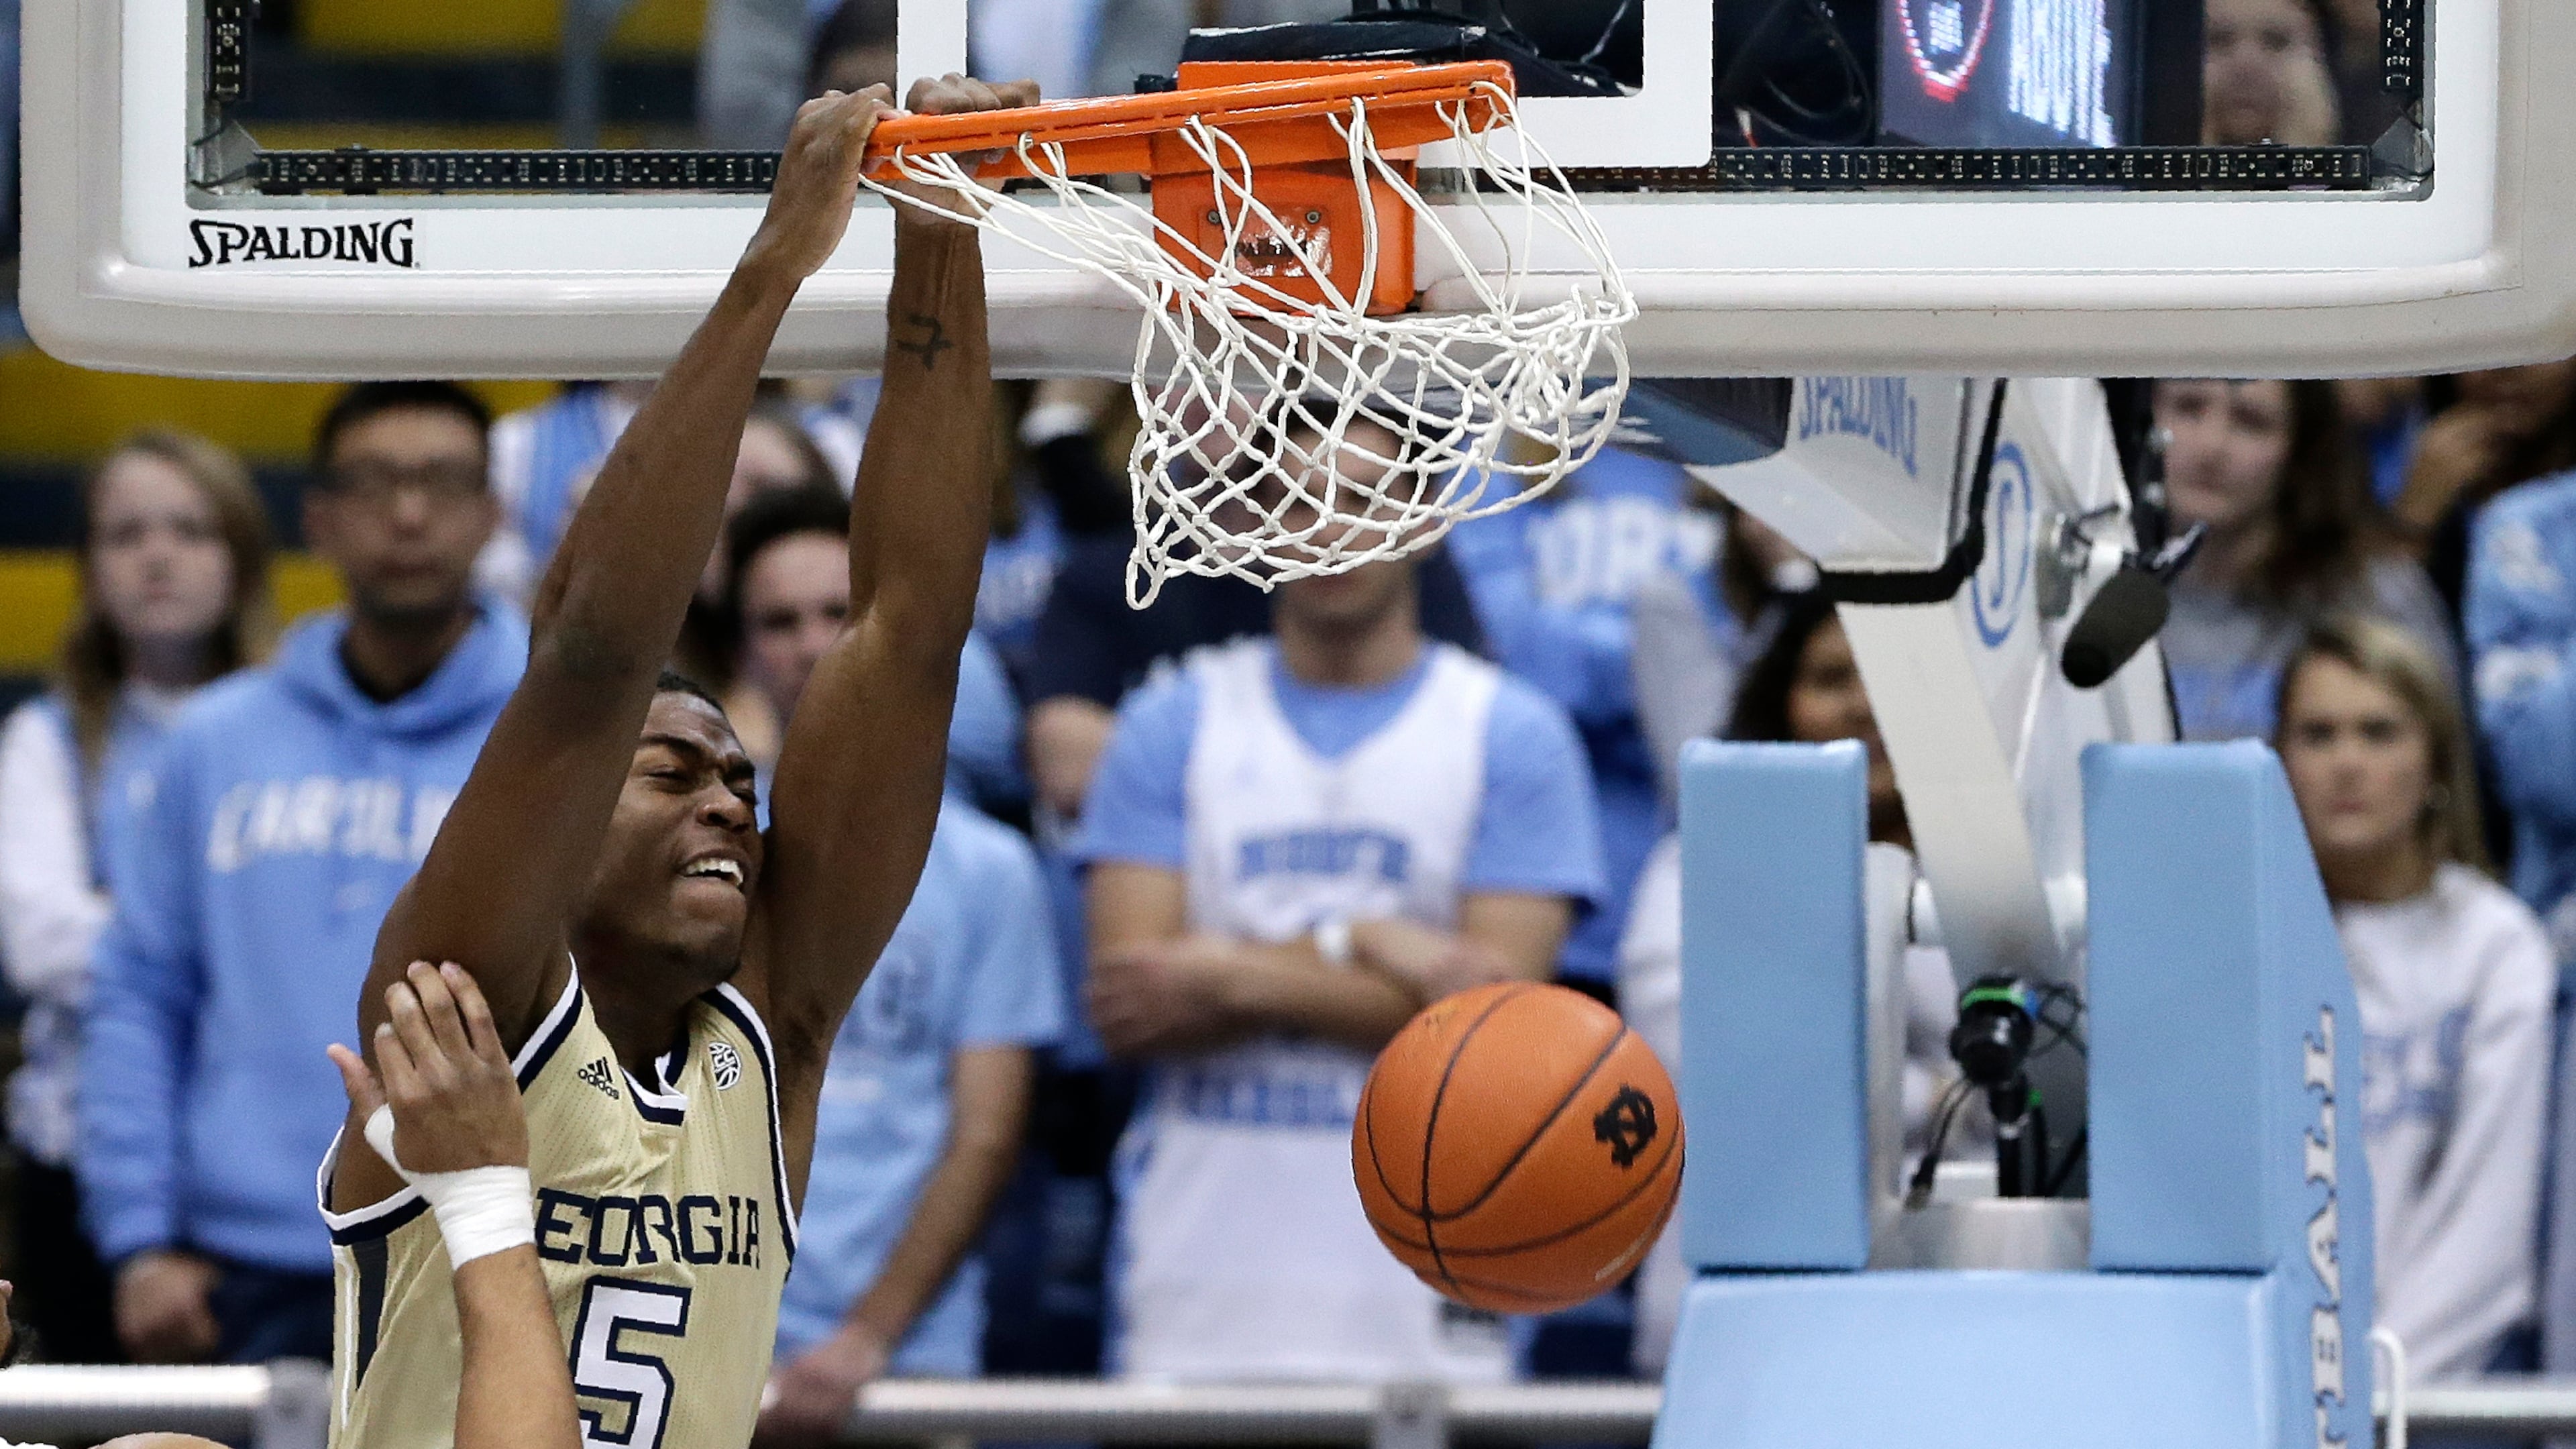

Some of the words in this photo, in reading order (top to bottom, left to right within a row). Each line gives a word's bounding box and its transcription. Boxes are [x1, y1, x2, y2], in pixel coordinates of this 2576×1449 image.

[189, 218, 413, 268] SPALDING
[578, 1068, 620, 1099] adidas
[535, 1187, 760, 1270] EORGIA
[569, 1275, 692, 1449] 5
